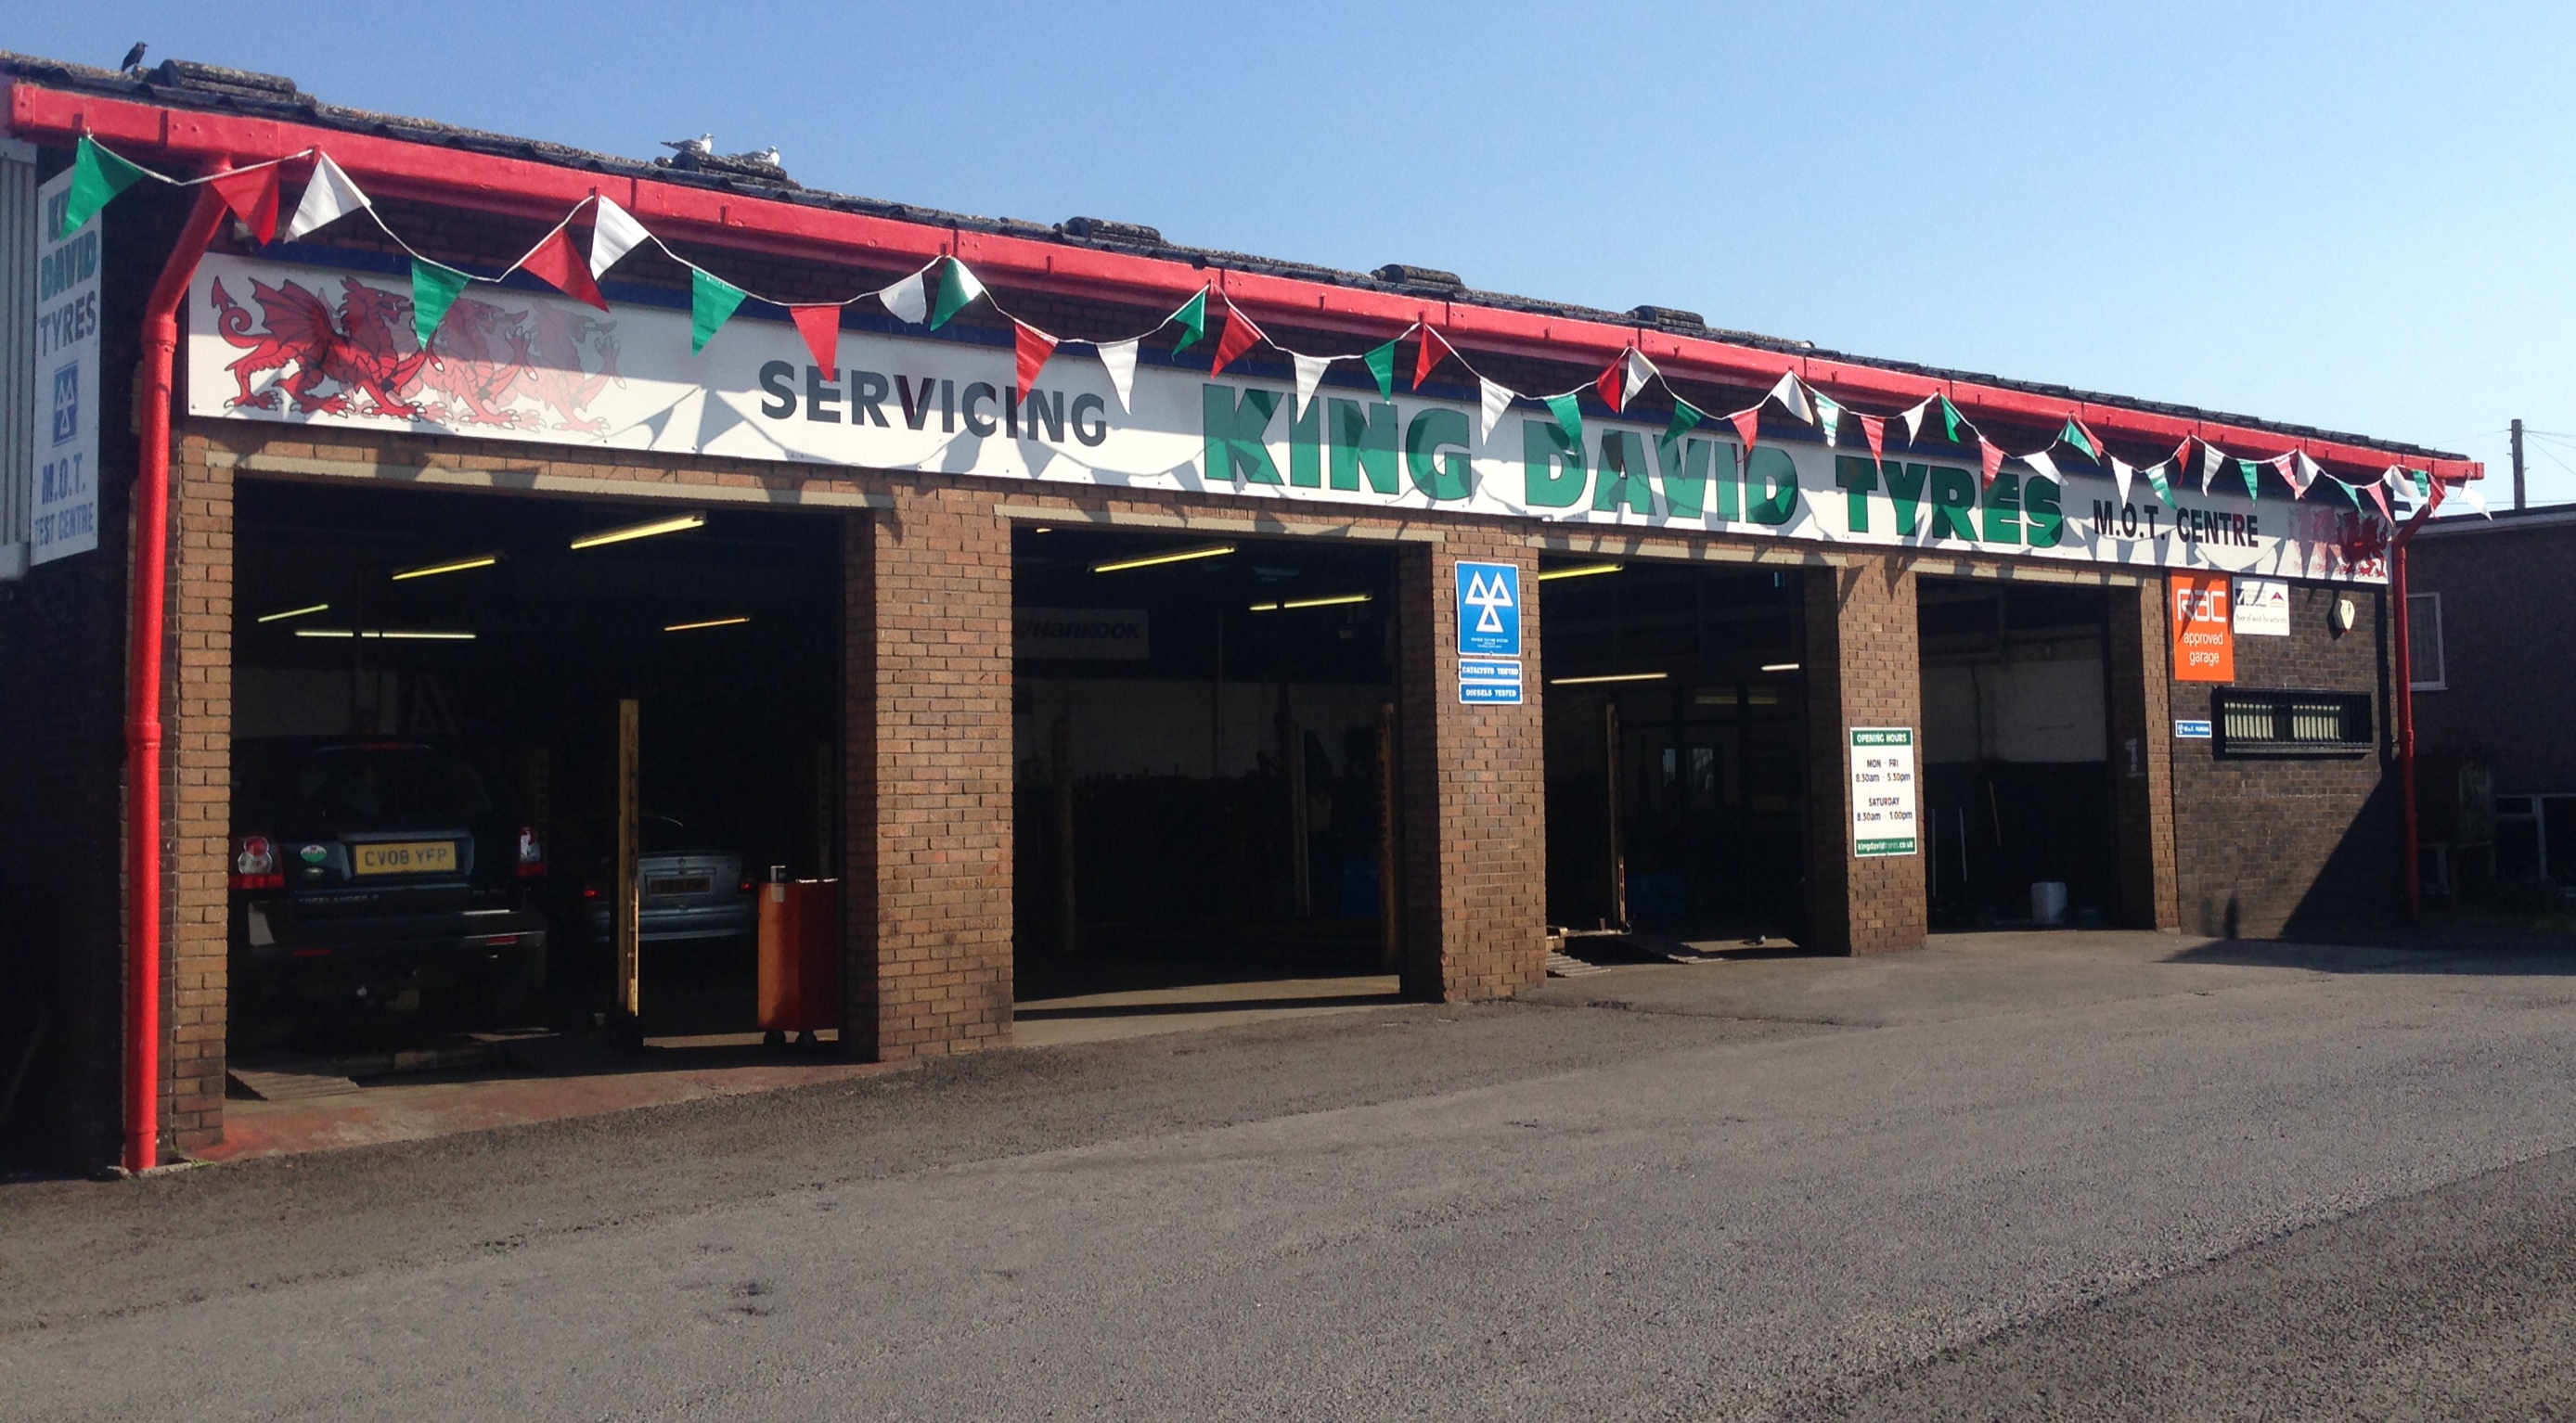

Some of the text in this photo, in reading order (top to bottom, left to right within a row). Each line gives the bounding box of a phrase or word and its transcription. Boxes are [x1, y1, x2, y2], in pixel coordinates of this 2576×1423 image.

[41, 229, 97, 303] DAVID
[38, 290, 97, 357] TYRES
[758, 360, 1107, 447] SERVICING
[1203, 383, 2065, 549] KING DAVID TYRES
[42, 453, 86, 506] M.O.T.
[34, 502, 95, 546] TEST CENTRE
[2093, 499, 2259, 549] M.O.T. CENTRE
[2183, 632, 2223, 646] approved
[2189, 652, 2220, 666] garage
[1495, 689, 1517, 698] TESTED
[1857, 733, 1907, 742] OPENING HOURS
[1867, 759, 1882, 768] MON
[1889, 759, 1899, 767] FRI
[1856, 774, 1880, 782] 8.30am
[1887, 773, 1911, 783] 5.30pm
[1869, 798, 1900, 807] SATURDAY
[365, 849, 409, 866] CV08
